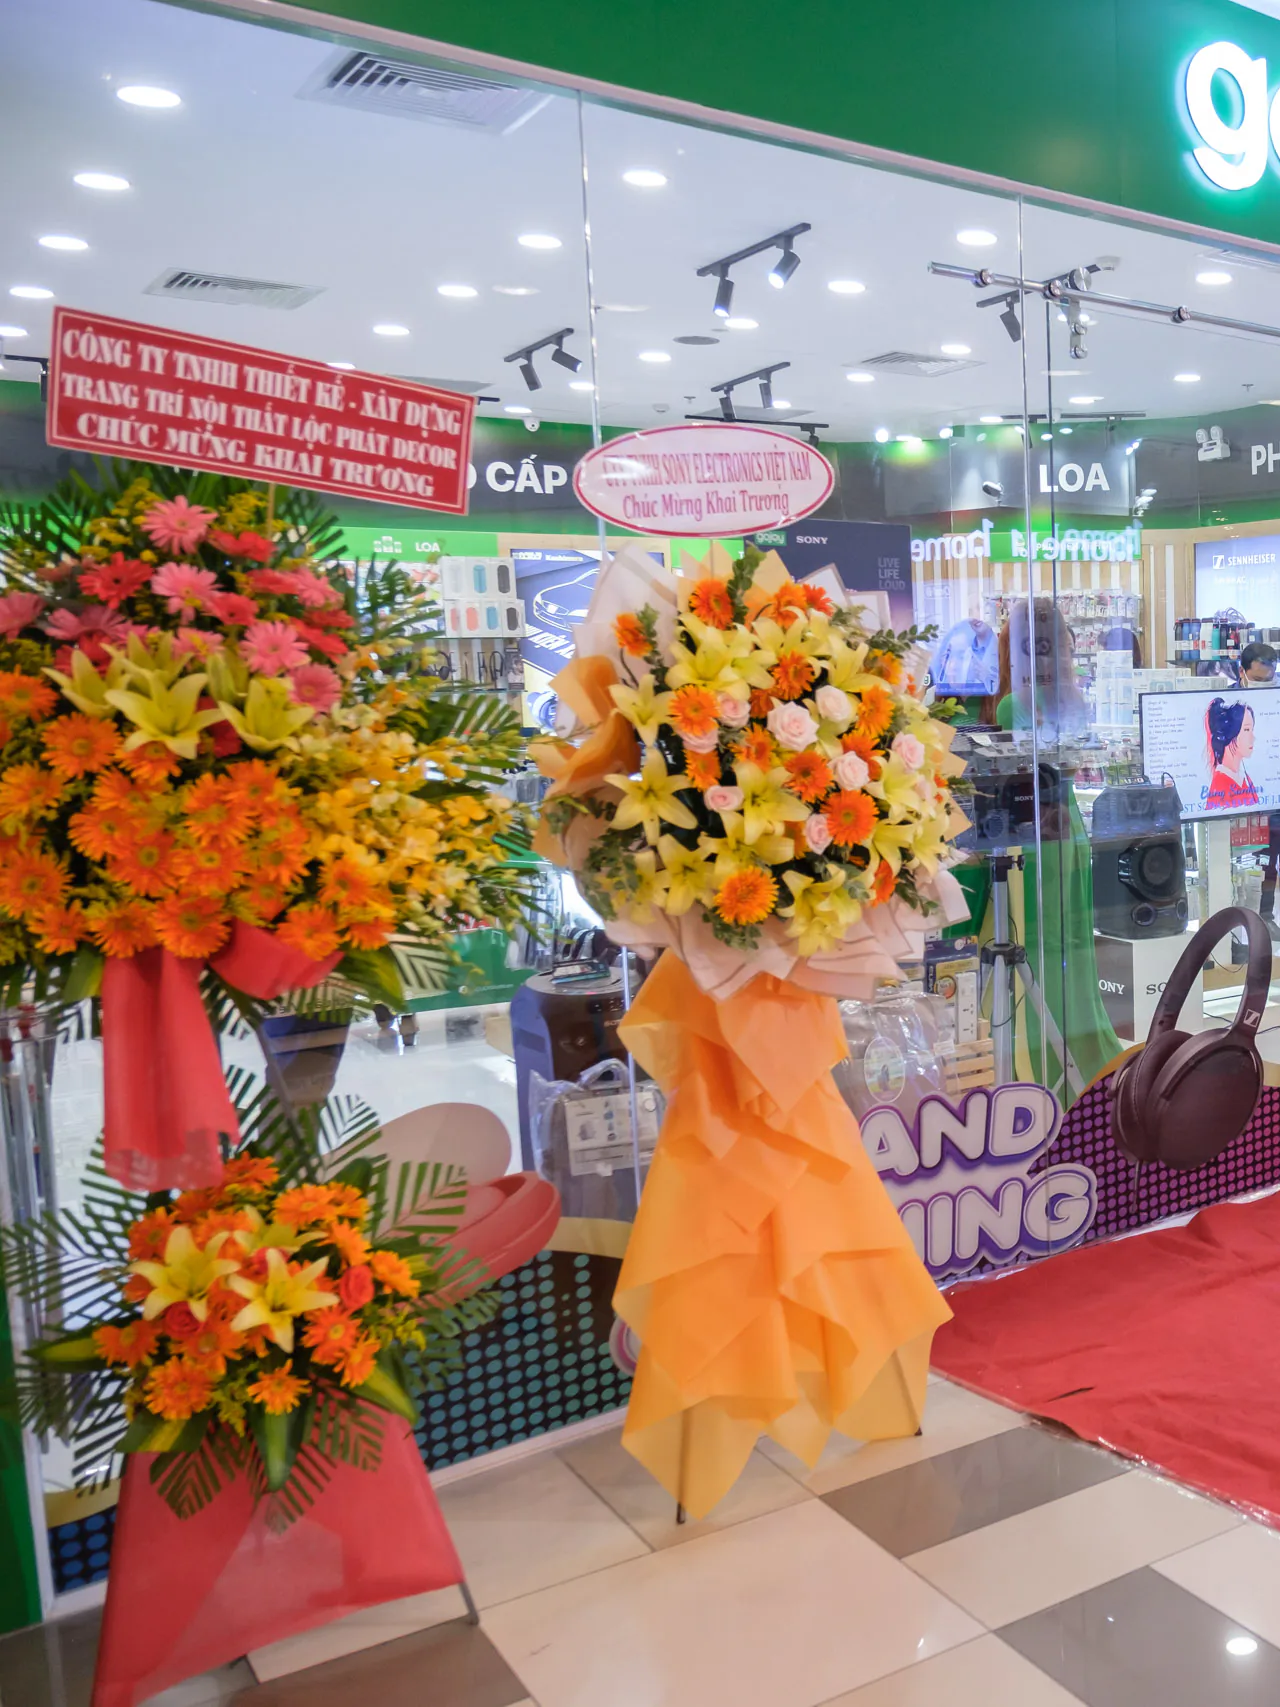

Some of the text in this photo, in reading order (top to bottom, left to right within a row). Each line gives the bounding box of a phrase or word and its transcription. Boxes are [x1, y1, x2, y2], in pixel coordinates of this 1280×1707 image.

[62, 326, 132, 369] CÔNG
[137, 342, 169, 375] TY
[173, 350, 239, 389] TNHH
[243, 364, 311, 403] THIẾT
[315, 374, 345, 412] KẾ
[360, 388, 404, 423] XÂY
[404, 400, 461, 439] DỰNG
[61, 372, 458, 470] TRANG TRÍ NỘI THẤT LỘC PHÁT DECOR
[76, 412, 159, 449] CHÚC
[164, 425, 247, 463] MỪNG
[253, 444, 324, 478] KHAI
[329, 456, 435, 497] TRƯƠNG
[485, 453, 568, 495] CẤP
[662, 453, 692, 486] SONY
[694, 452, 763, 485] ELECTRONICS
[763, 444, 788, 489] VIỆT
[789, 450, 812, 482] NAM
[1038, 462, 1111, 493] LOA
[622, 490, 790, 521] Chúc Mừng Khai Trương
[415, 542, 440, 553] LOA
[796, 535, 828, 545] SONY
[878, 557, 900, 569] LIVE
[1227, 553, 1276, 566] SENNHEISER
[878, 568, 900, 580] LIFE
[878, 580, 906, 591] LOUD
[1258, 796, 1271, 806] OF
[1098, 979, 1126, 995] ONY
[1145, 981, 1168, 995] SO
[859, 1082, 1060, 1184] AND
